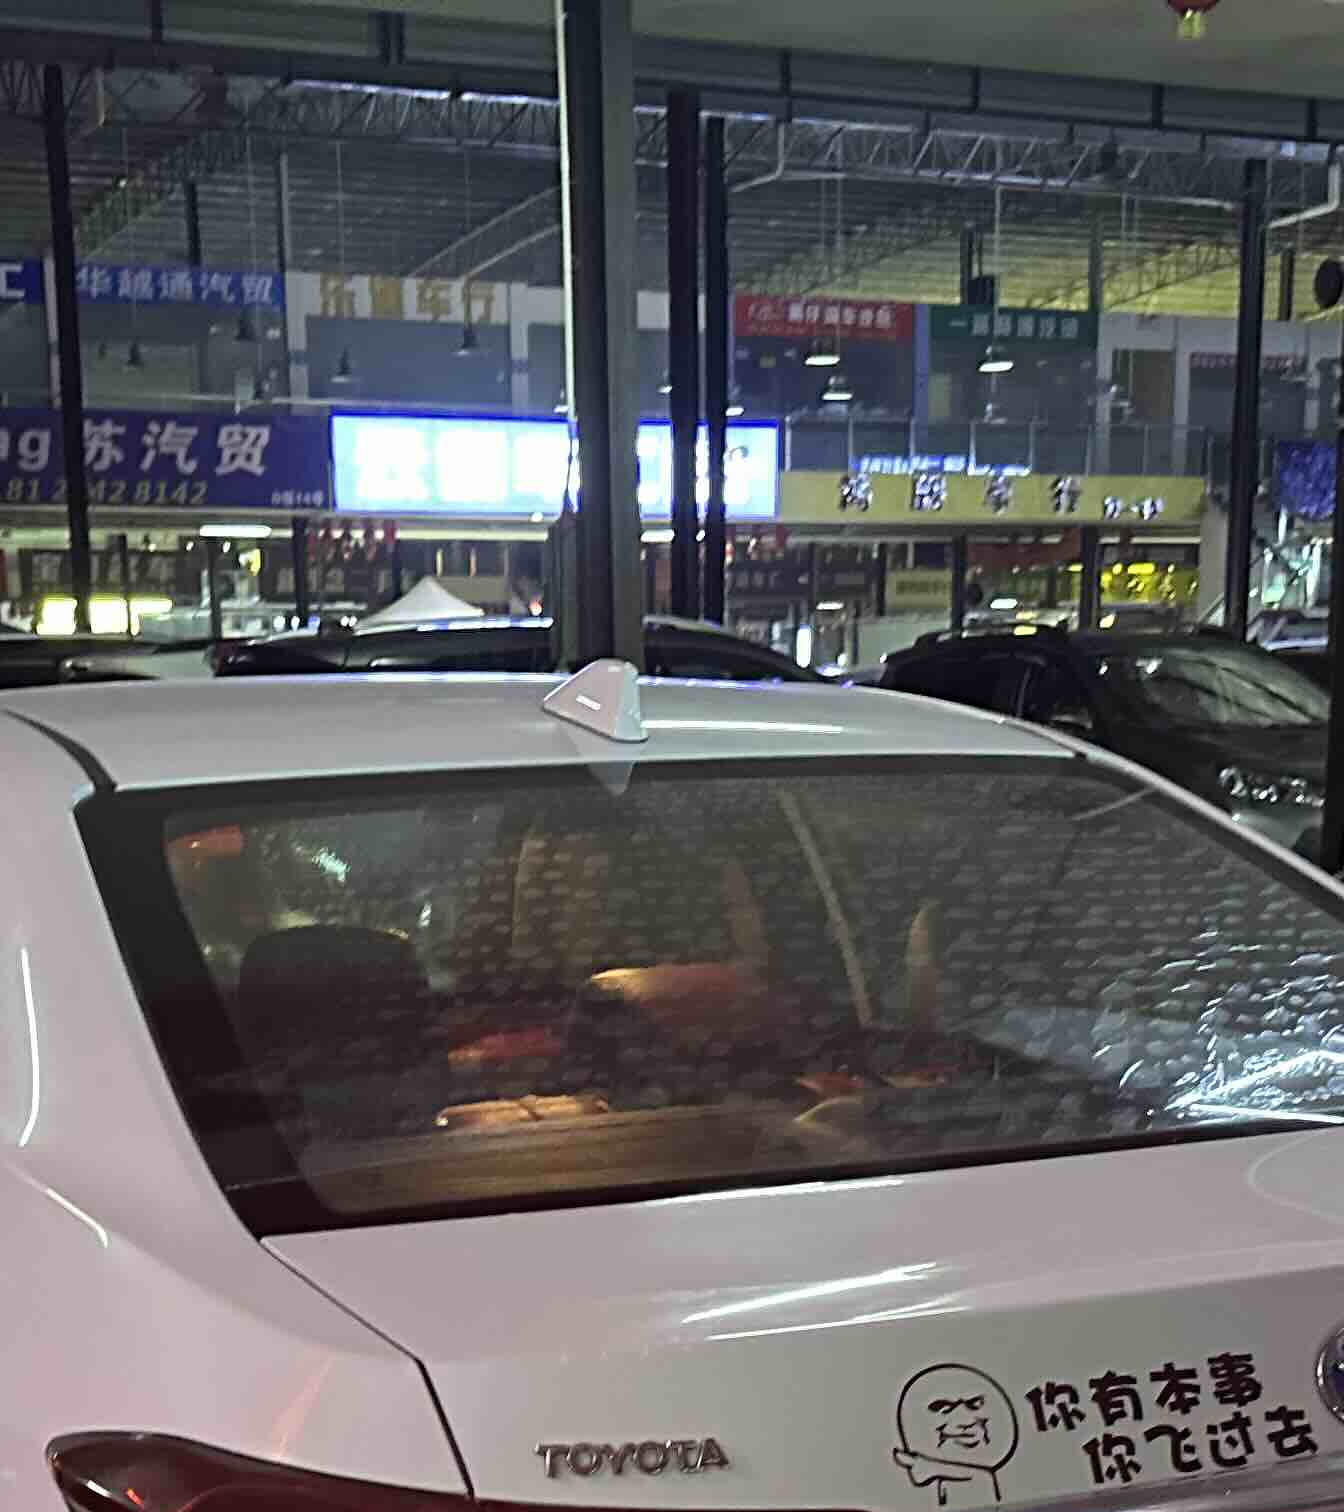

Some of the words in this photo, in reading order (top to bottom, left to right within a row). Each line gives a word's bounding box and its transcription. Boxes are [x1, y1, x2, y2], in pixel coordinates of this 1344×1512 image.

[1025, 1352, 1263, 1432] 你有本事
[533, 1438, 732, 1479] TOYOTA
[1081, 1405, 1319, 1484] 你飞过去
